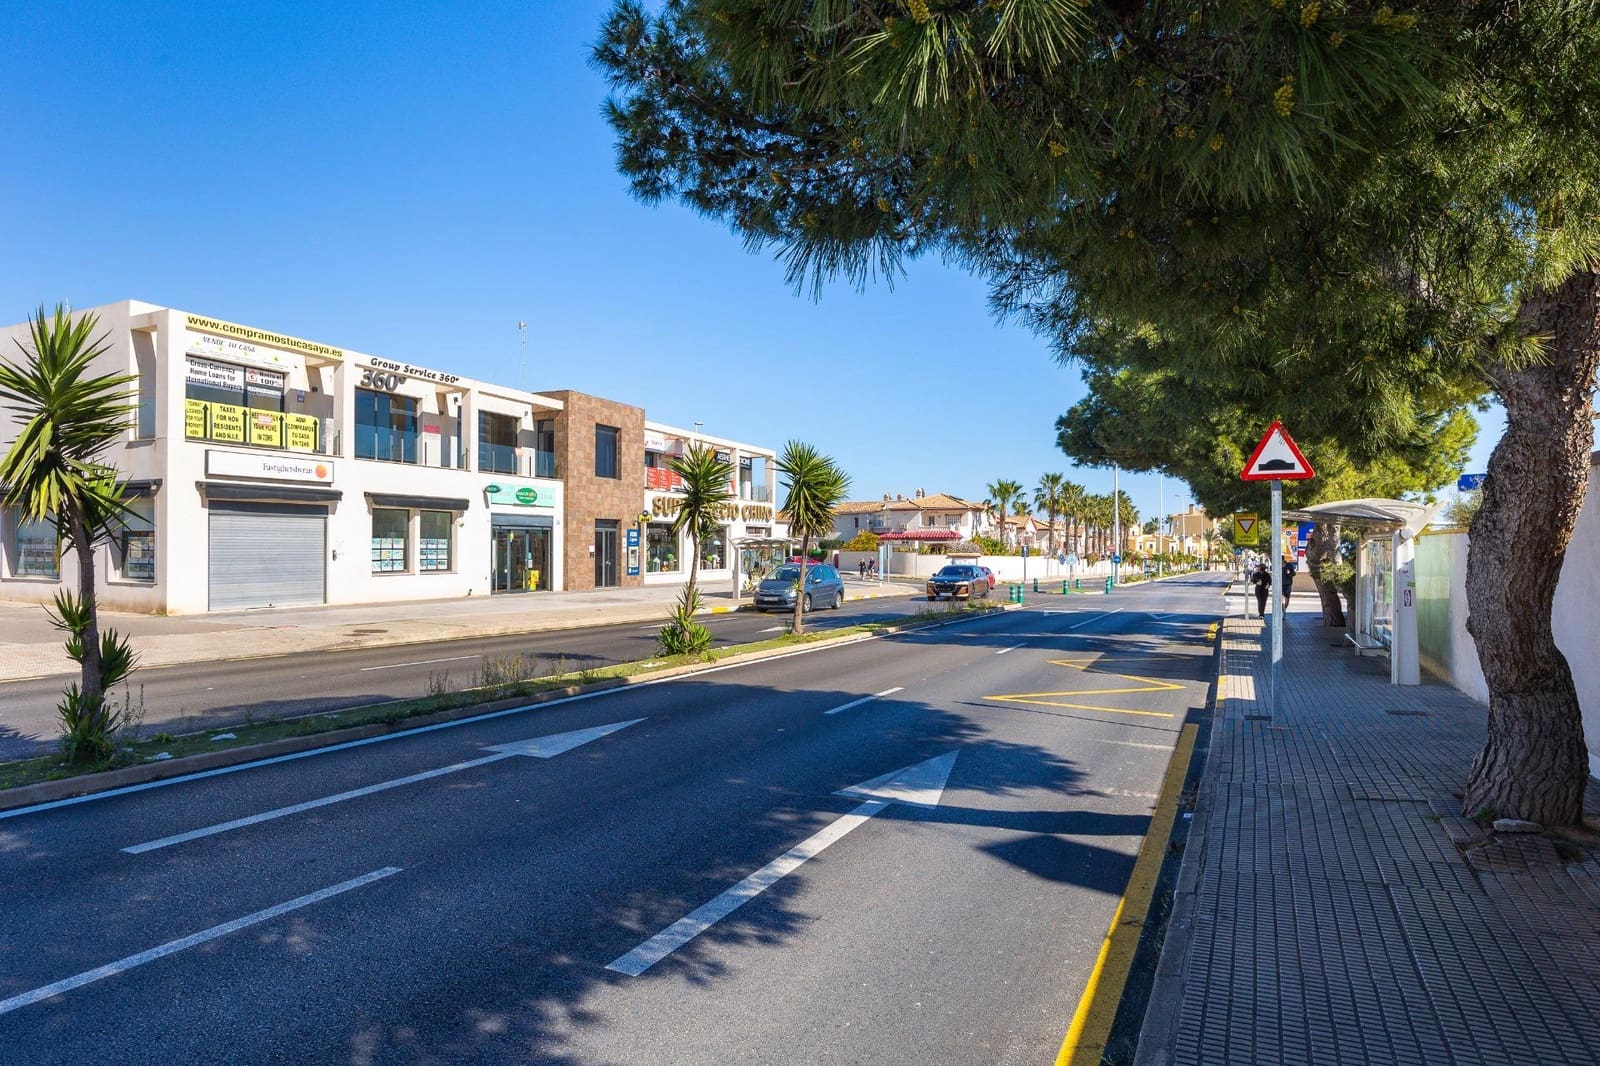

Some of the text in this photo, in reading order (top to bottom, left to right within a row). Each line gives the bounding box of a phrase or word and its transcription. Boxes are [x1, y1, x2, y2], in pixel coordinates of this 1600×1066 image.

[187, 315, 343, 358] www.compramostucasaya.es
[190, 359, 236, 375] Cross-Currency
[370, 357, 401, 371] Group
[403, 365, 437, 380] Service
[190, 368, 236, 382] Home Loans for
[219, 405, 236, 413] TAXES
[216, 413, 227, 421] FOR
[214, 422, 242, 432] RESIDENTS
[741, 504, 773, 523] CHINO
